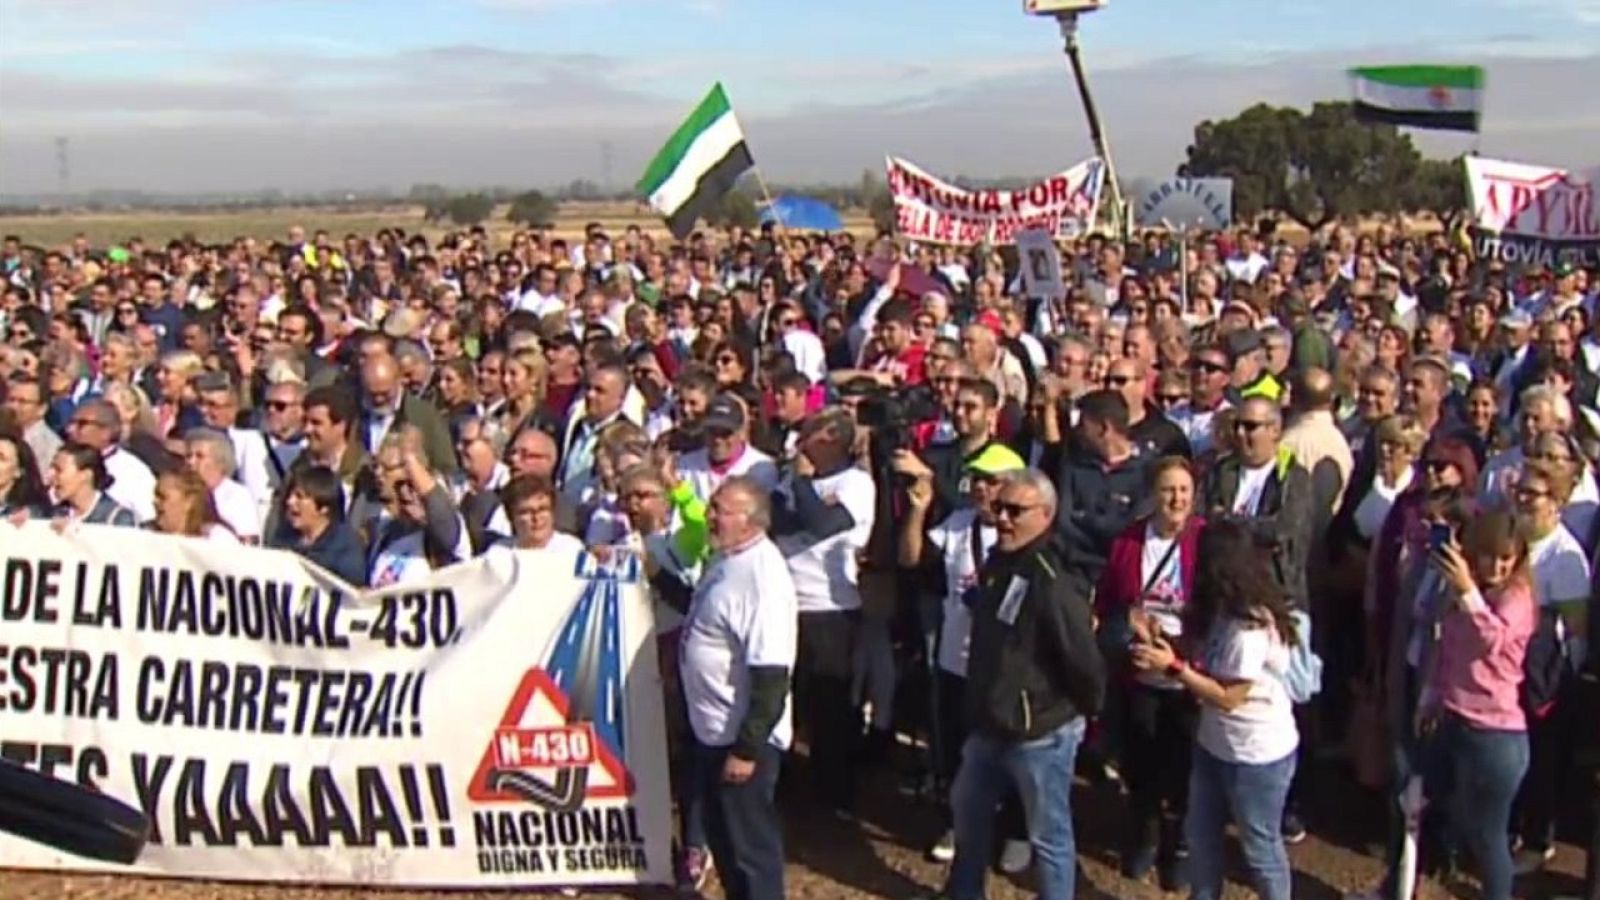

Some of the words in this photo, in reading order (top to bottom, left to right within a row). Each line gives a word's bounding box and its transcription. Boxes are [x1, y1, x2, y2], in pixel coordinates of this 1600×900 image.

[1011, 177, 1068, 211] POR
[3, 557, 62, 622] DE
[72, 562, 123, 630] LA
[135, 655, 427, 738] CARRETERA!!
[498, 729, 591, 766] N-430
[131, 752, 457, 848] YAAAAA!!
[473, 805, 645, 848] NACIONAL
[476, 850, 545, 874] DIGNA
[546, 849, 559, 872] Y
[564, 846, 649, 872] SEGURA
